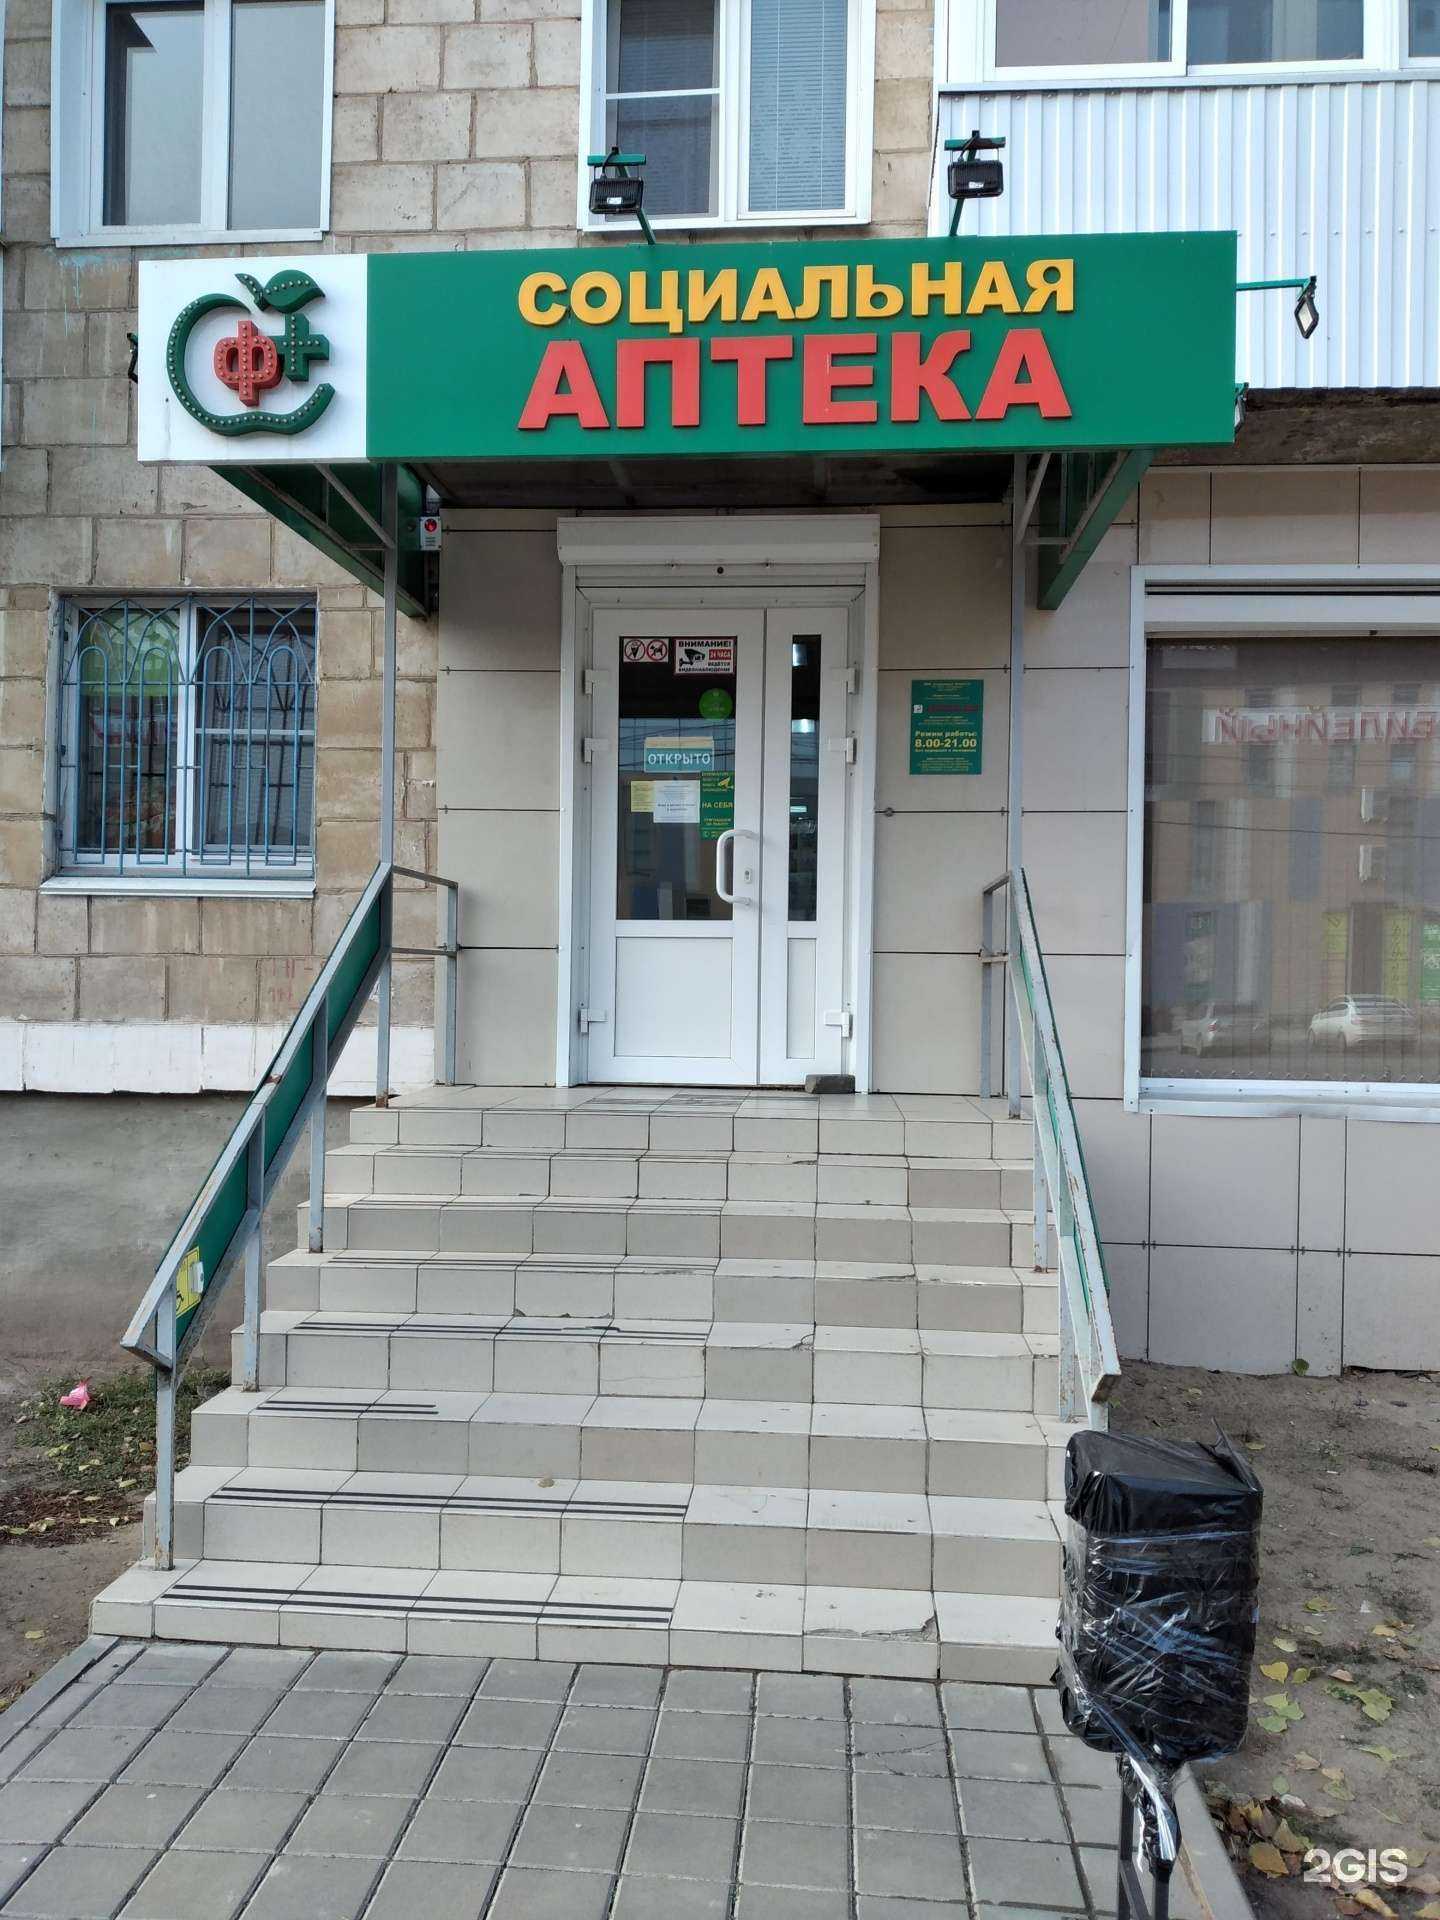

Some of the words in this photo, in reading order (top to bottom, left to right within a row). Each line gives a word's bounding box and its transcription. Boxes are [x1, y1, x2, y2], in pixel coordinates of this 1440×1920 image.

[518, 258, 1074, 334] СОЦИАЛЬНАЯ
[517, 328, 1073, 430] АПТЕКА
[678, 640, 732, 648] ВНИМАНИЕ!
[914, 738, 978, 748] 8.00-21.00
[648, 752, 711, 765] ОТКРЫТО
